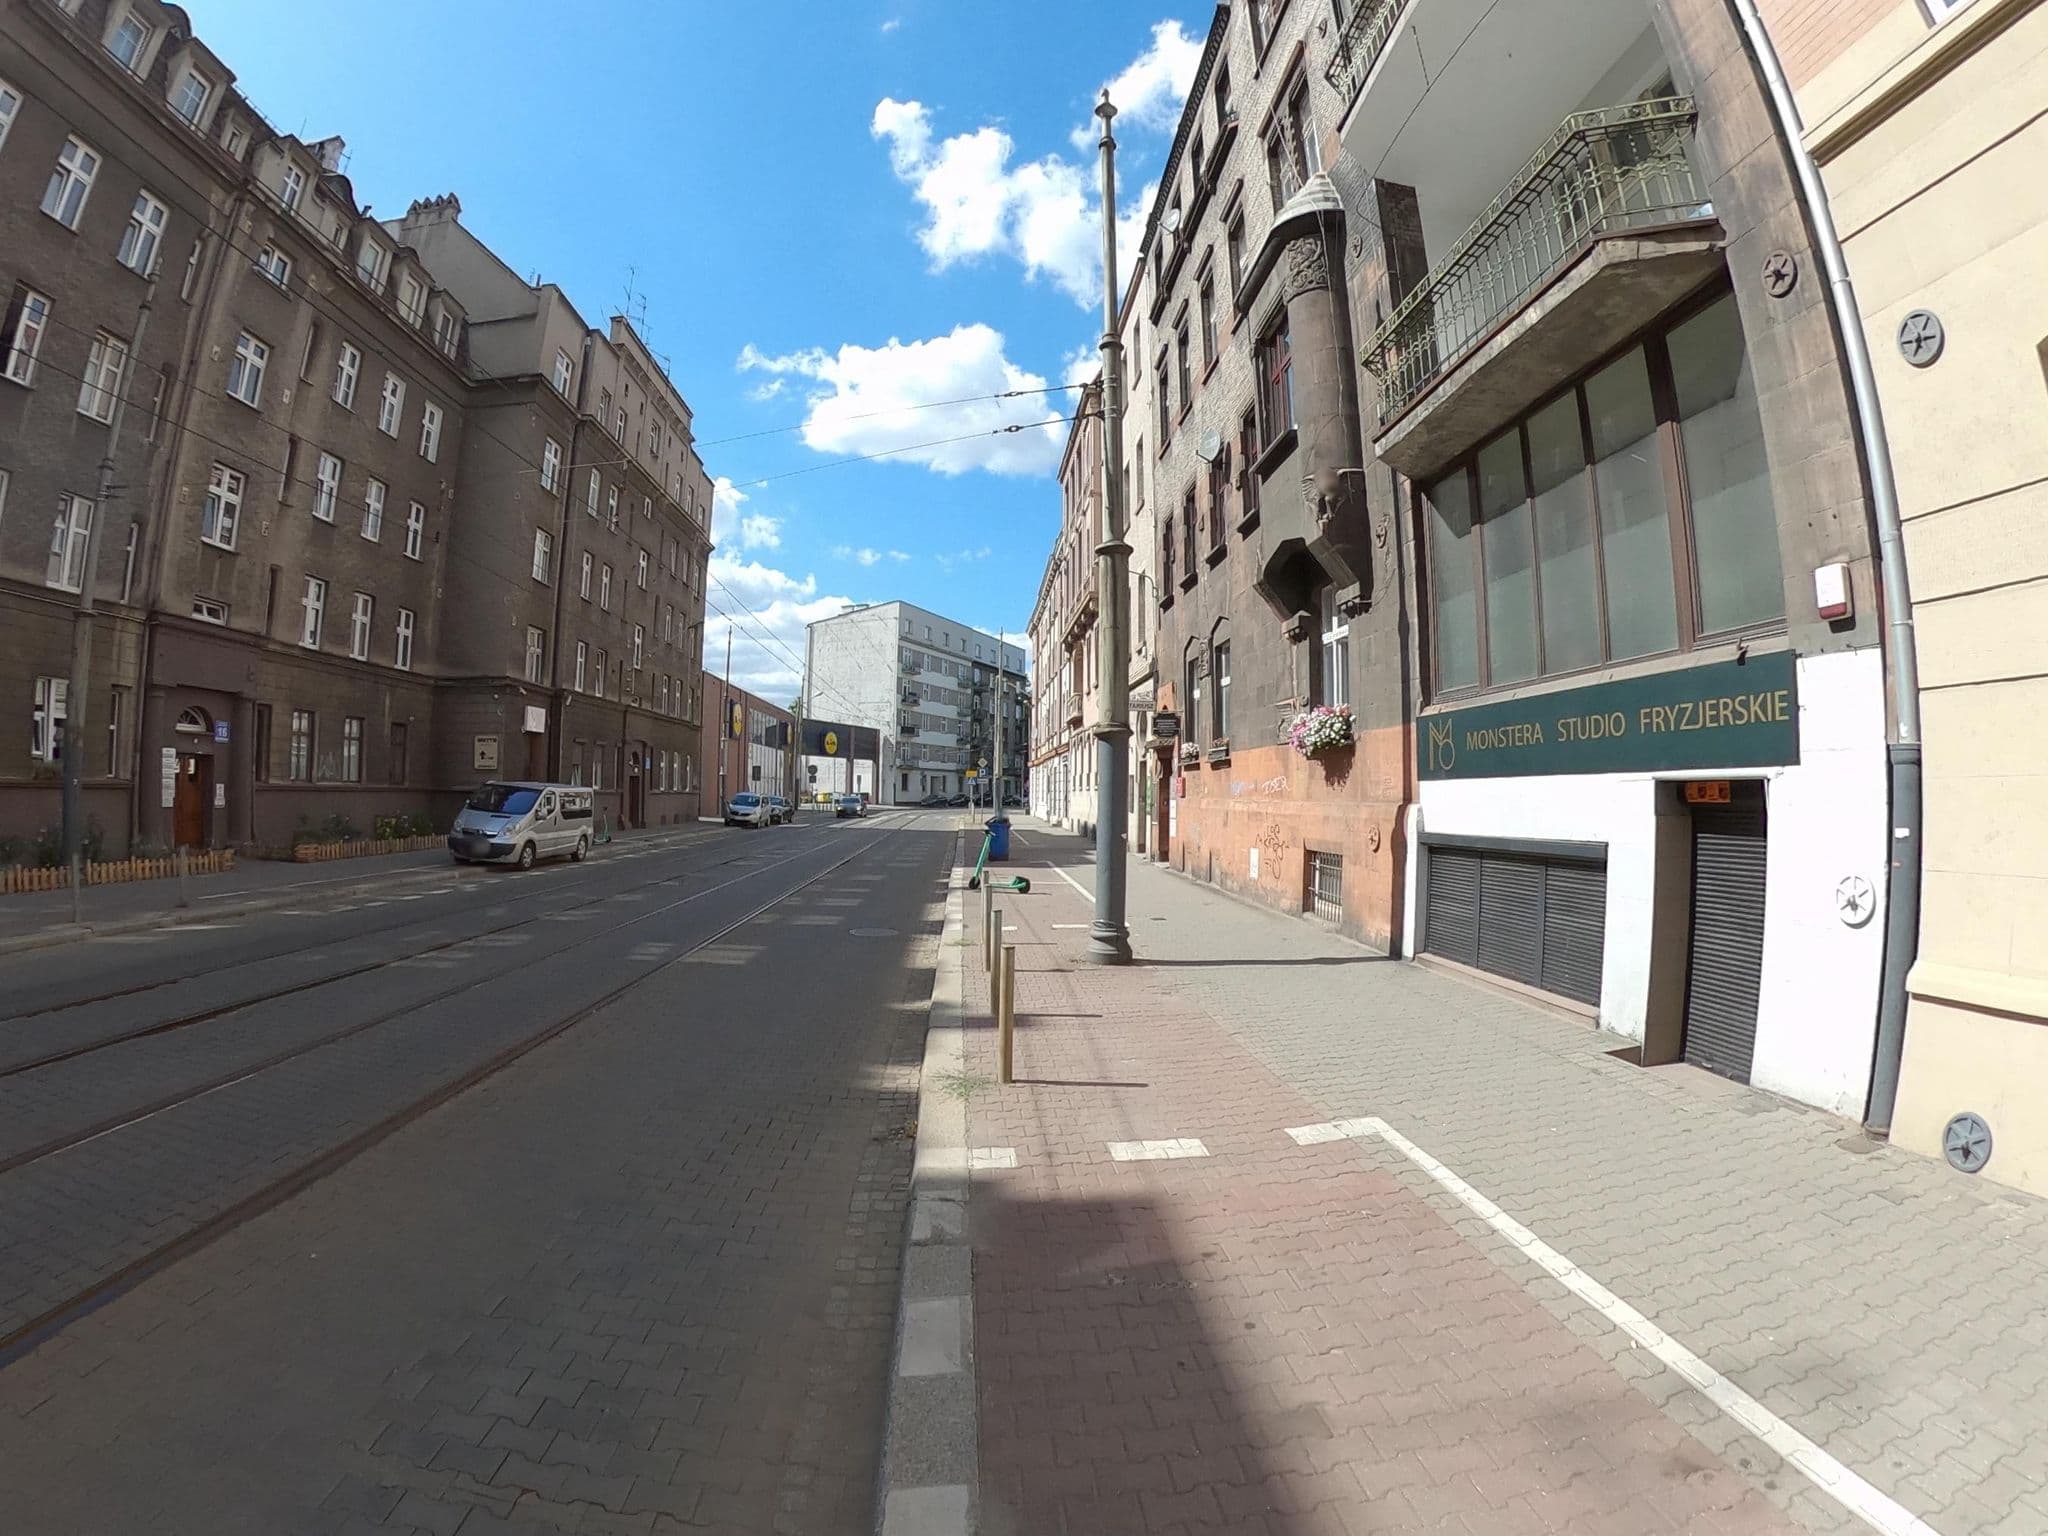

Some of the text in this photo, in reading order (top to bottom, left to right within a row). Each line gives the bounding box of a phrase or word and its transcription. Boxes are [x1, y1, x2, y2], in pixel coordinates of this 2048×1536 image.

[1466, 690, 1790, 751] MONSTERA STUDIO FRYZJERSKIE
